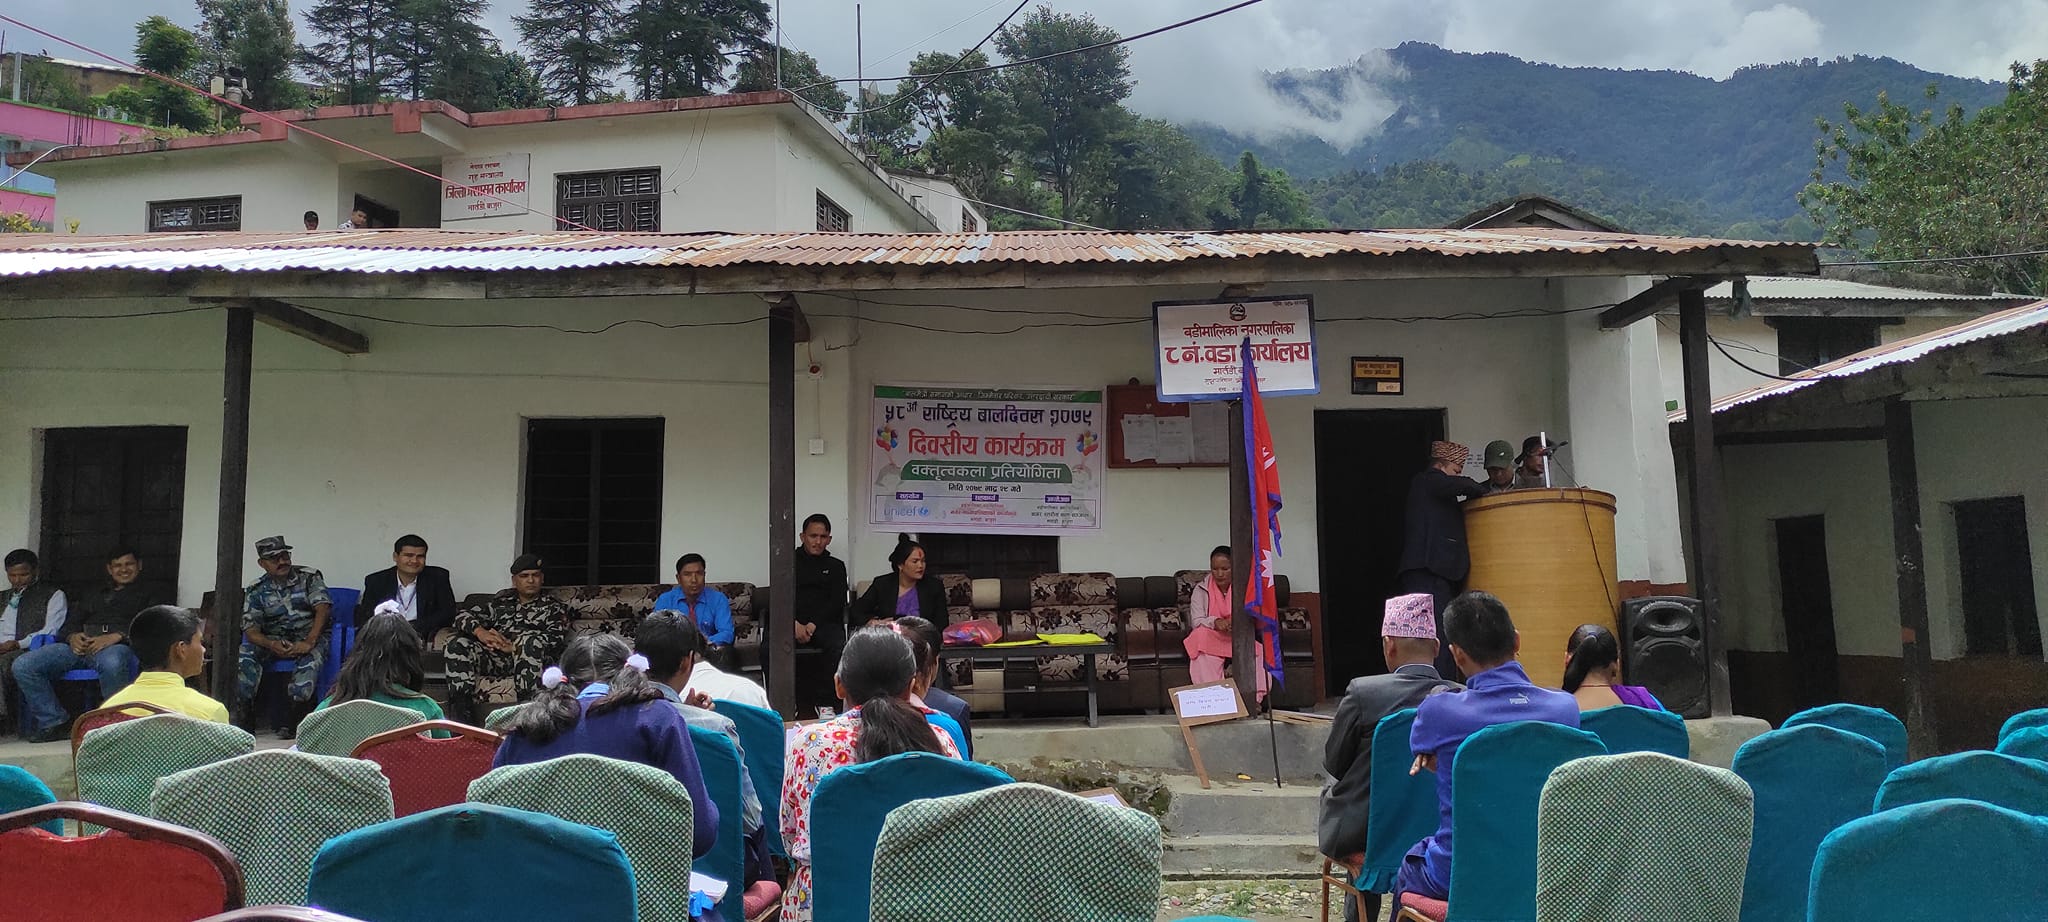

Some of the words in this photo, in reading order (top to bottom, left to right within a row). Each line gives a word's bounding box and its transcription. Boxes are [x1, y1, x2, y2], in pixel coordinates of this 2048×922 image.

[445, 185, 466, 199] जिल्ला
[495, 178, 526, 195] कार्यालय
[1241, 320, 1295, 337] नगरपालिका
[922, 403, 972, 428] राष्ट्रिय
[978, 405, 1044, 424] बालदिवस
[1050, 409, 1092, 427] २०७९
[908, 428, 979, 456] दिवसीय
[984, 432, 1066, 457] कार्यक्रम
[911, 463, 987, 480] वक्तृत्वकला
[990, 464, 1062, 480] प्रतियोगिता
[884, 504, 917, 517] unicef
